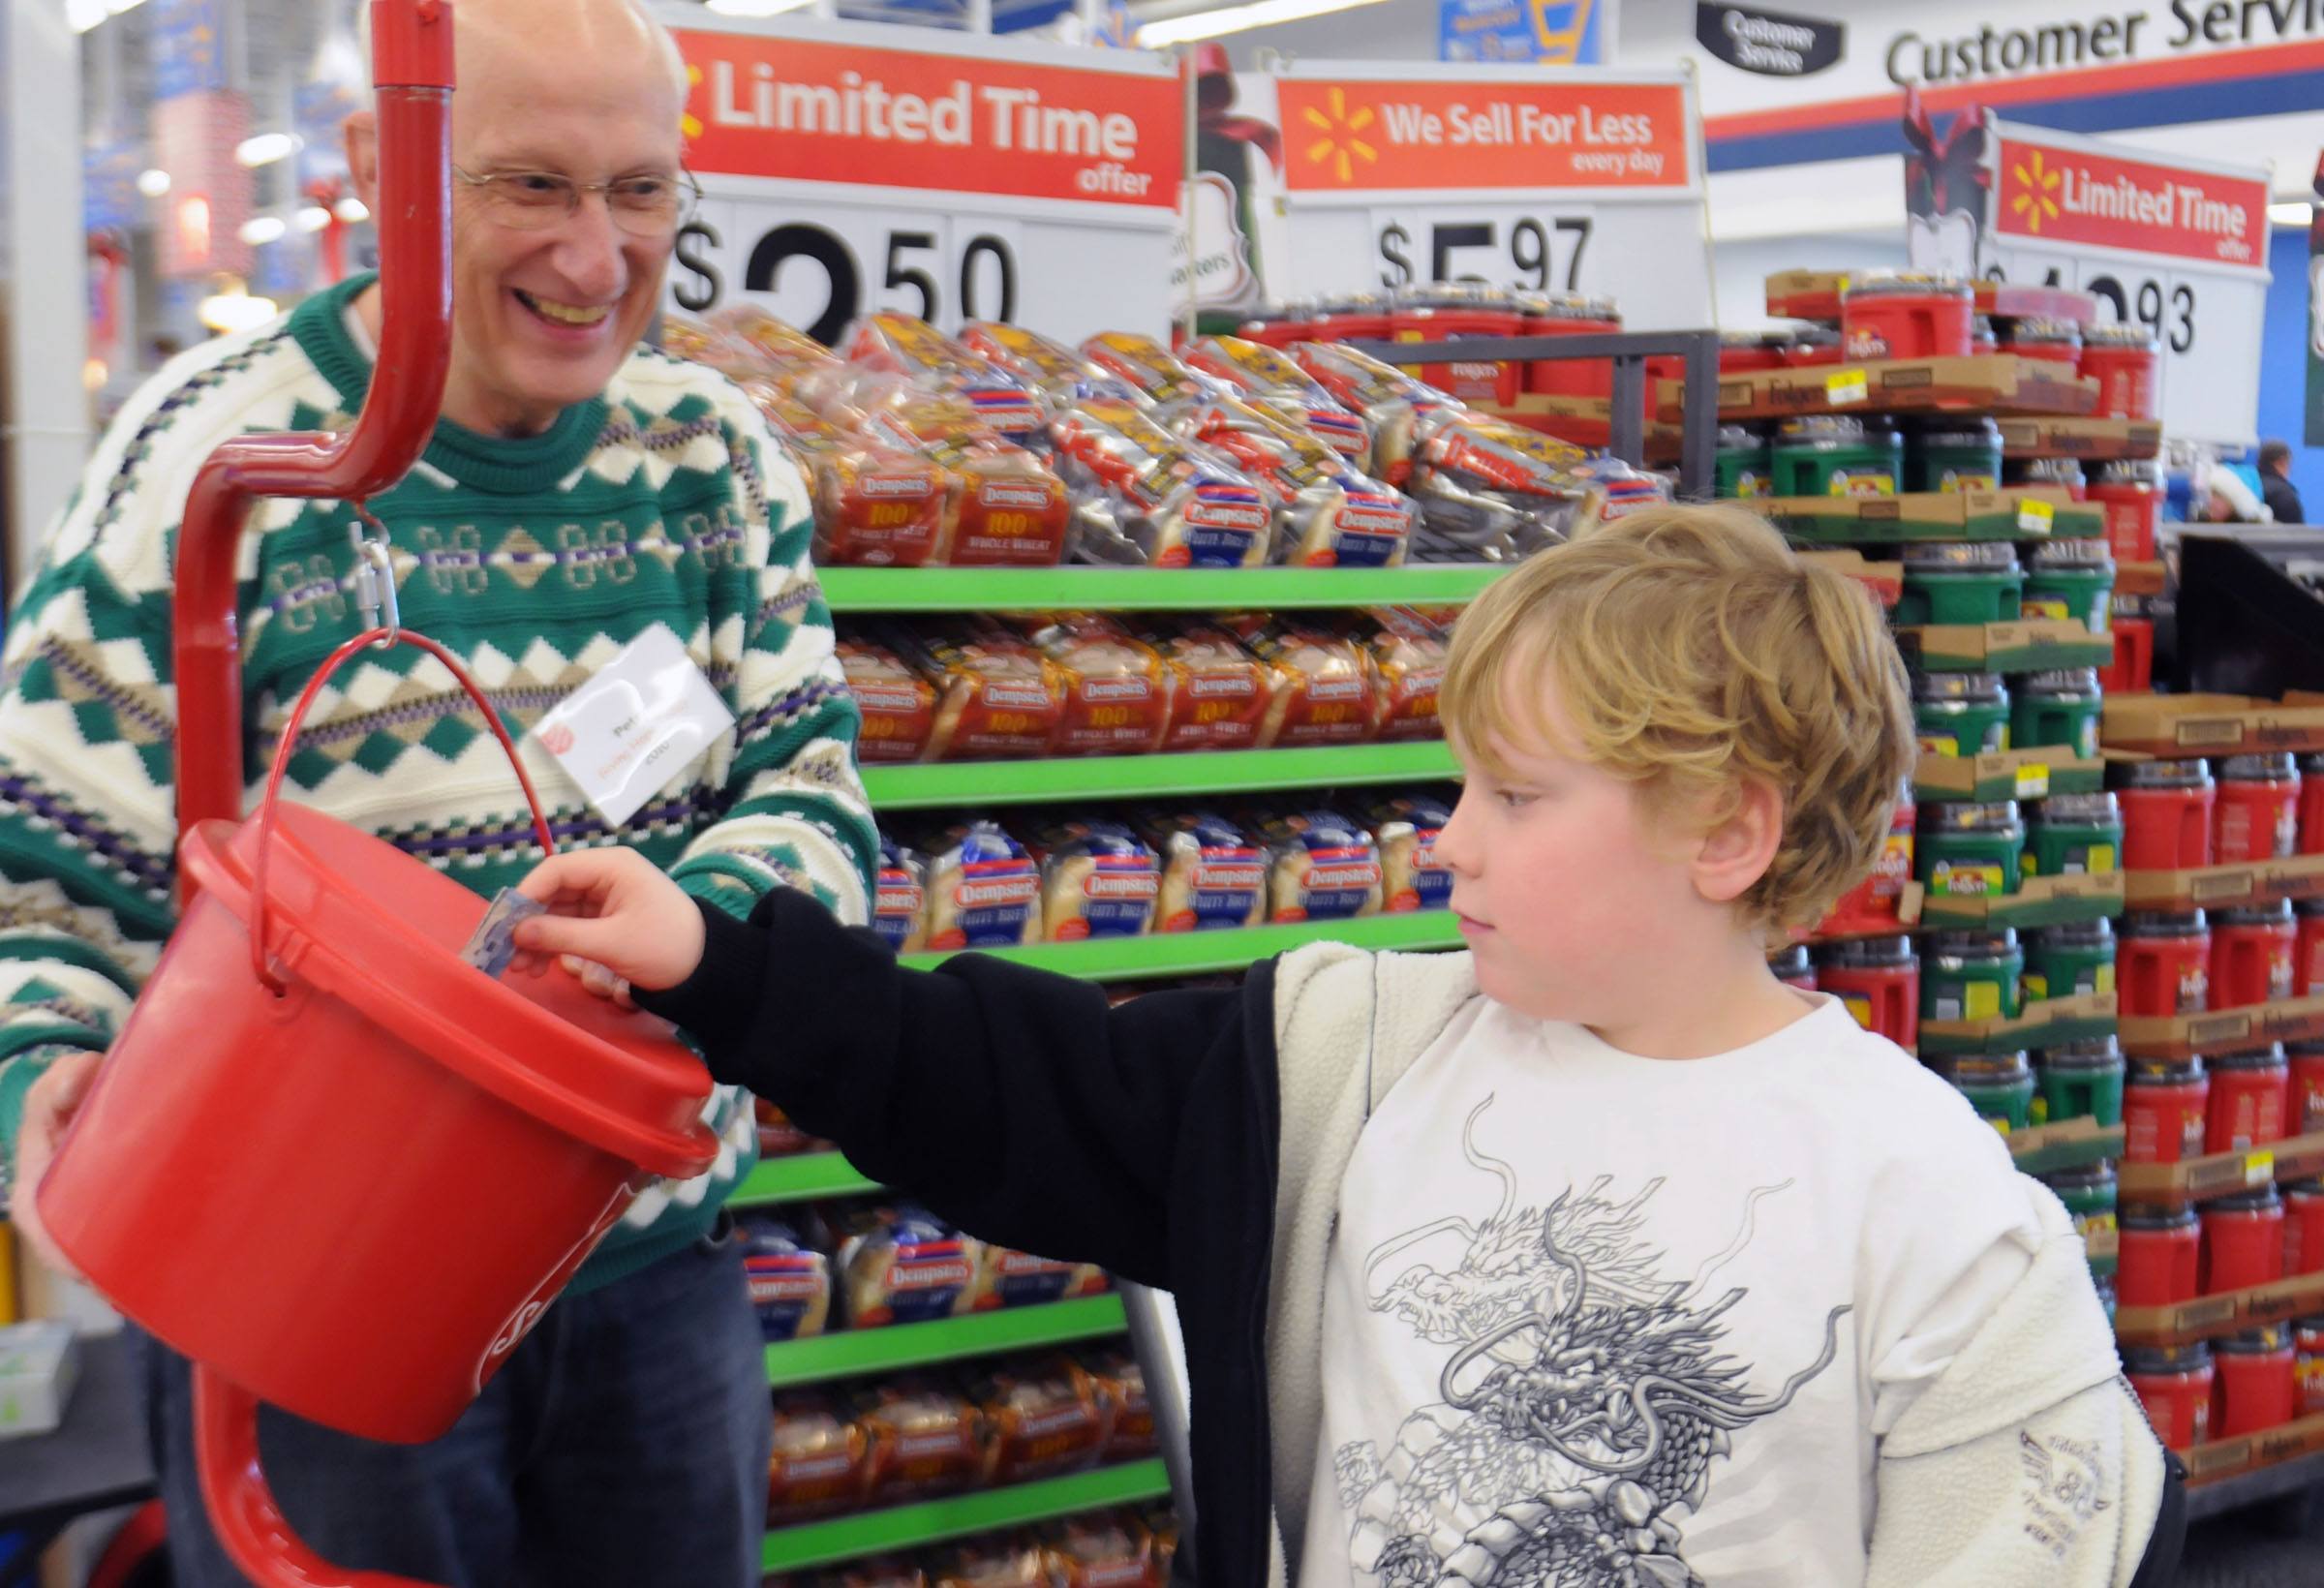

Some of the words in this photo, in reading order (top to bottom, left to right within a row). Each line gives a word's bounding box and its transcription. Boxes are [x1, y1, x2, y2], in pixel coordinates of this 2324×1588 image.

[1885, 11, 2149, 88] Customer
[2167, 0, 2324, 47] Servi
[713, 60, 971, 147] Limited
[981, 84, 1139, 159] Time
[1382, 103, 1443, 144] We
[1449, 101, 1514, 145] Sell
[1518, 104, 1576, 144] For
[1580, 105, 1654, 144] Less
[1077, 163, 1152, 196] offer
[1571, 151, 1628, 177] every
[1630, 147, 1665, 177] day
[2062, 167, 2176, 228] Limited
[2178, 185, 2248, 238] Time
